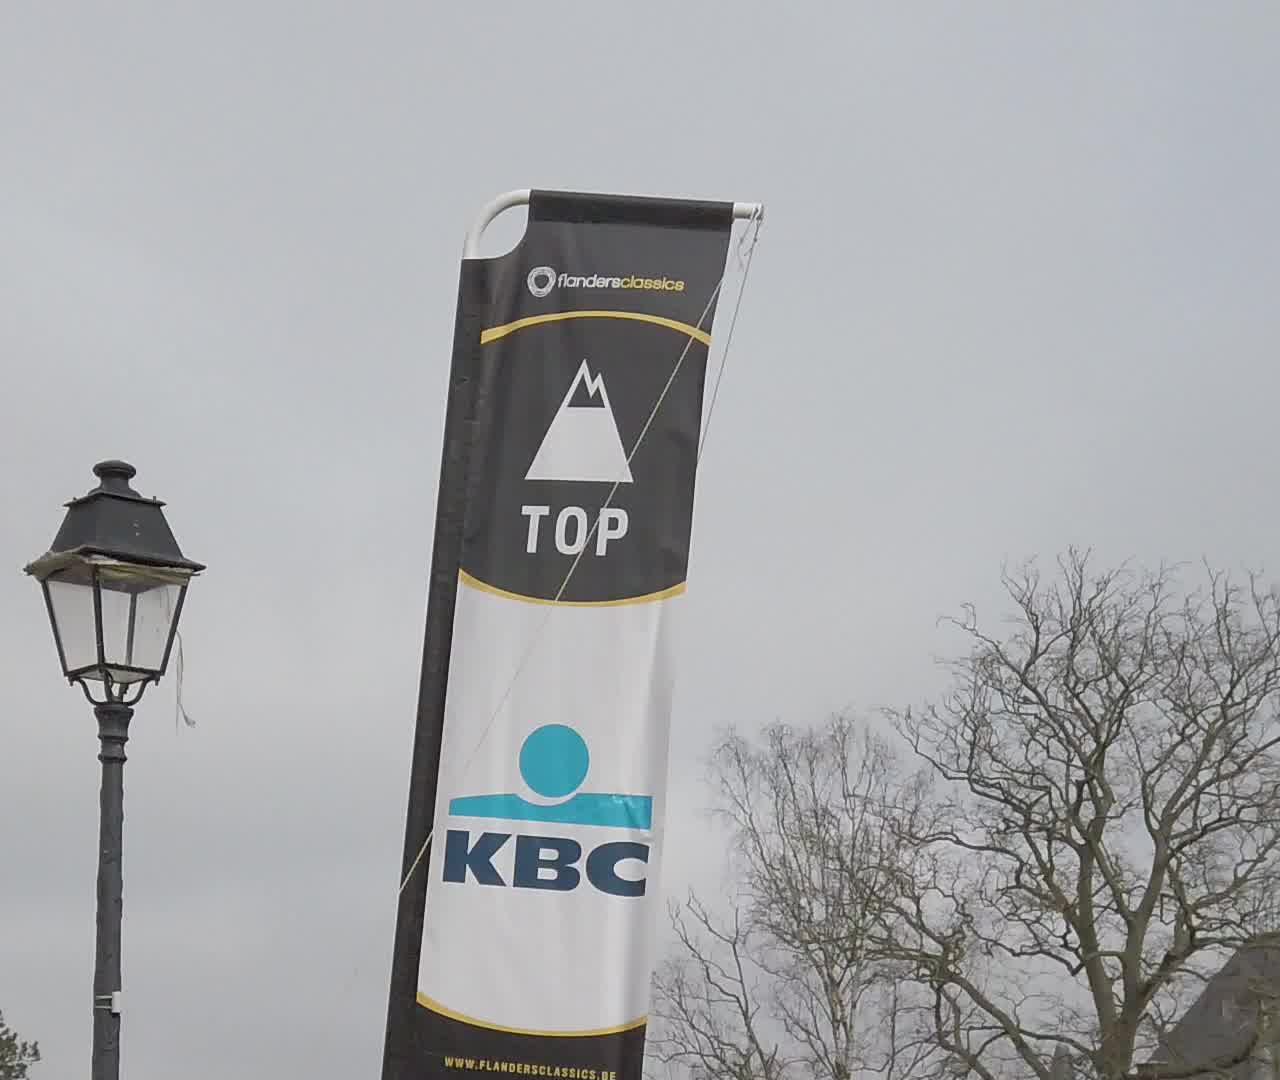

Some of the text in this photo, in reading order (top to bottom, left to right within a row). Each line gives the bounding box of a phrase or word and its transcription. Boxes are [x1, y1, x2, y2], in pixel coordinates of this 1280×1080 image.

[556, 272, 685, 292] flandersclassics
[521, 505, 629, 556] TOP
[442, 829, 650, 897] KBC
